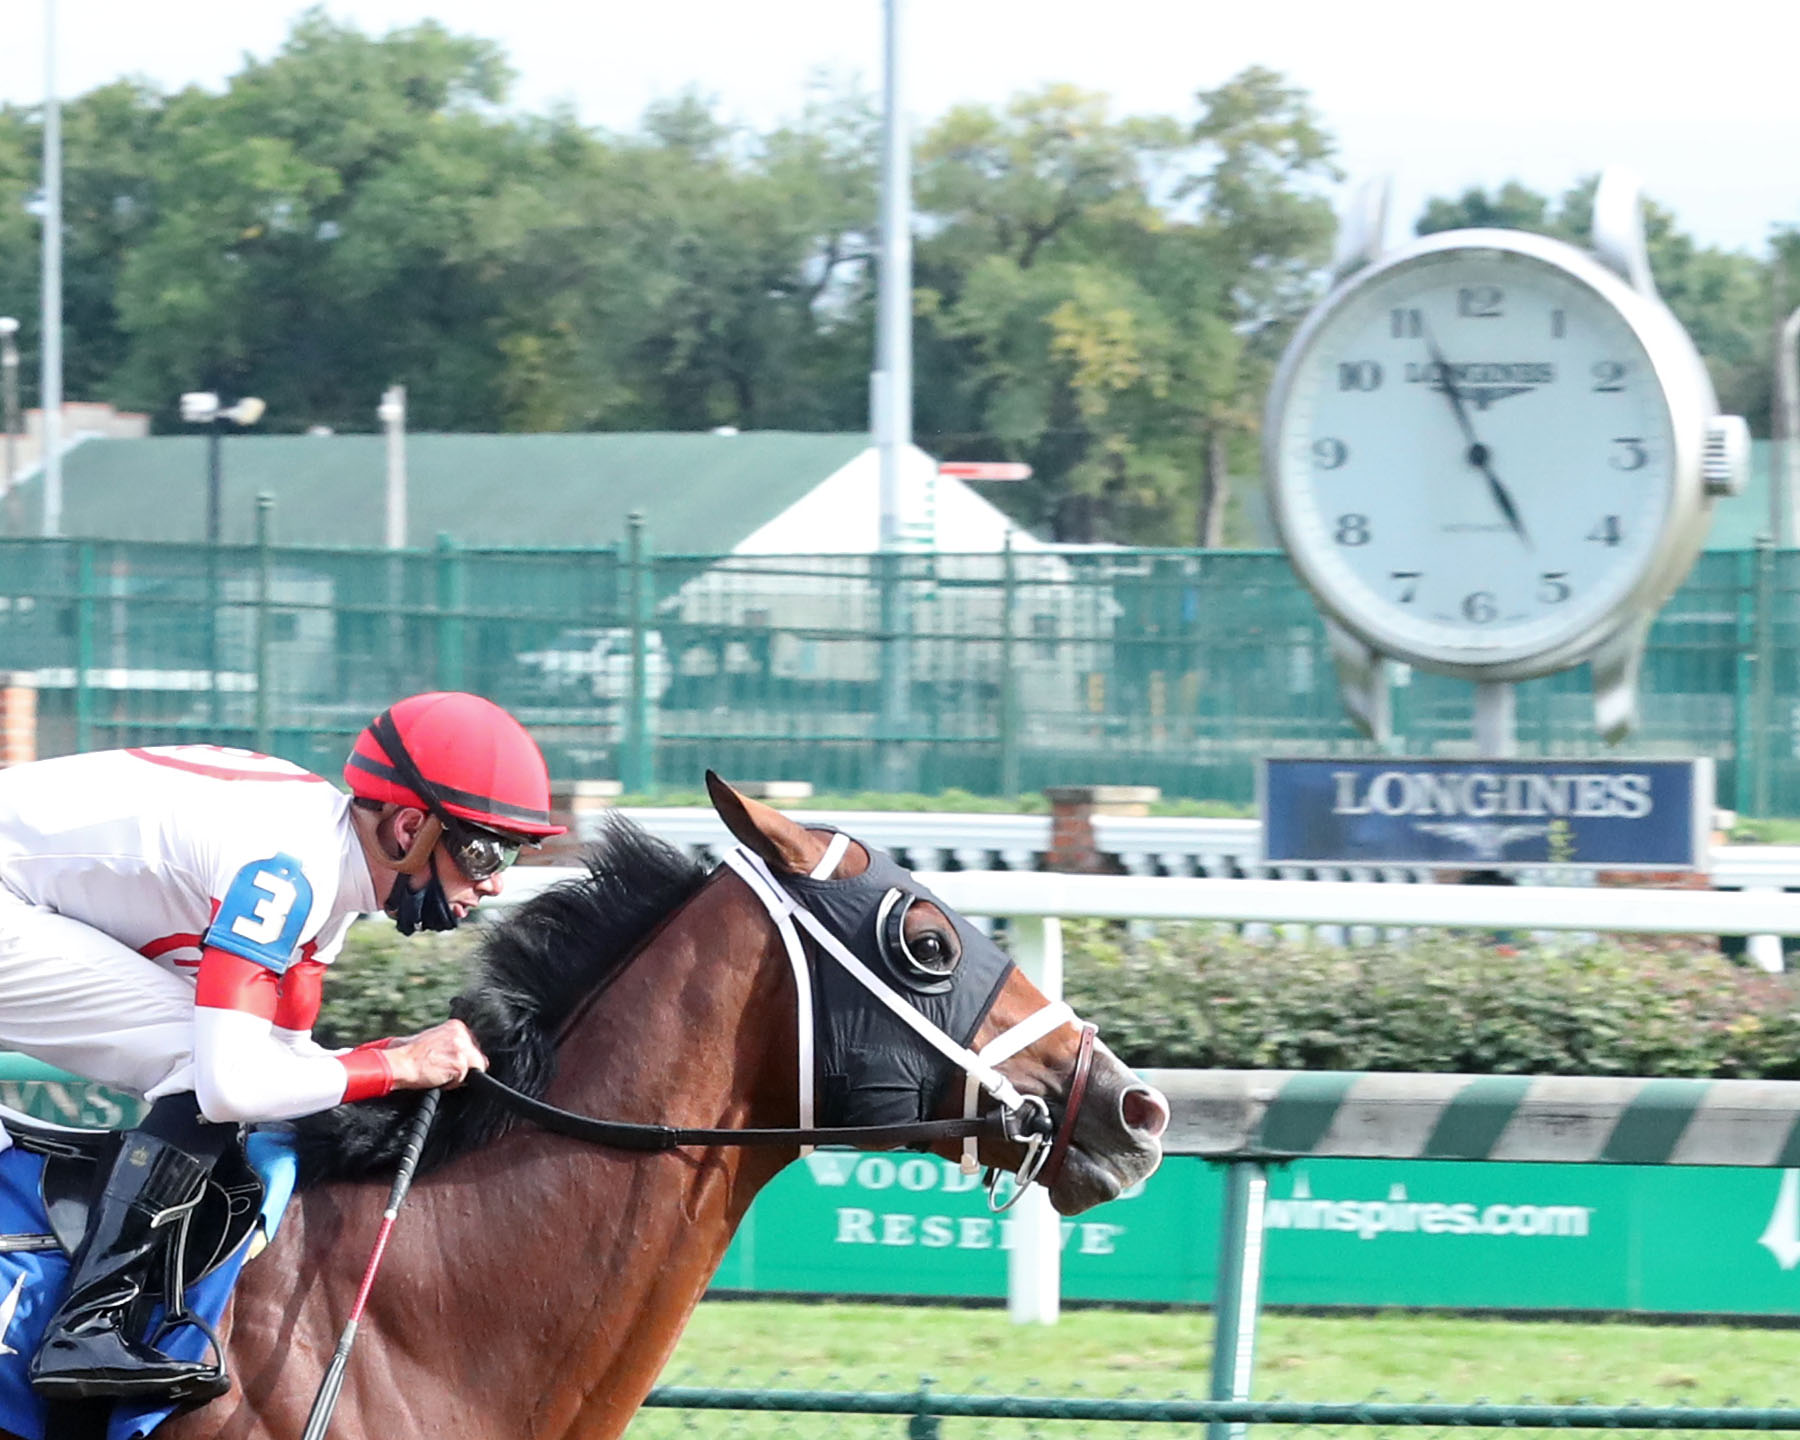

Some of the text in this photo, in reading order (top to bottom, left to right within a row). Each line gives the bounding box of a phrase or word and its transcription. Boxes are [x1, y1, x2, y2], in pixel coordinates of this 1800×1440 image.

[1457, 286, 1505, 318] 12
[1391, 309, 1423, 339] 11
[1551, 309, 1566, 339] 1
[1338, 360, 1384, 392] 10
[1591, 361, 1627, 393] 2
[1312, 438, 1348, 470] 9
[1609, 437, 1649, 471] 3
[1334, 514, 1372, 547] 8
[1584, 515, 1621, 547] 4
[1391, 571, 1423, 603] 7
[1538, 571, 1572, 604] 5
[1461, 591, 1498, 625] 6
[1333, 772, 1653, 819] LONGINES
[231, 869, 299, 945] 3
[1263, 1172, 1591, 1240] winspires.com
